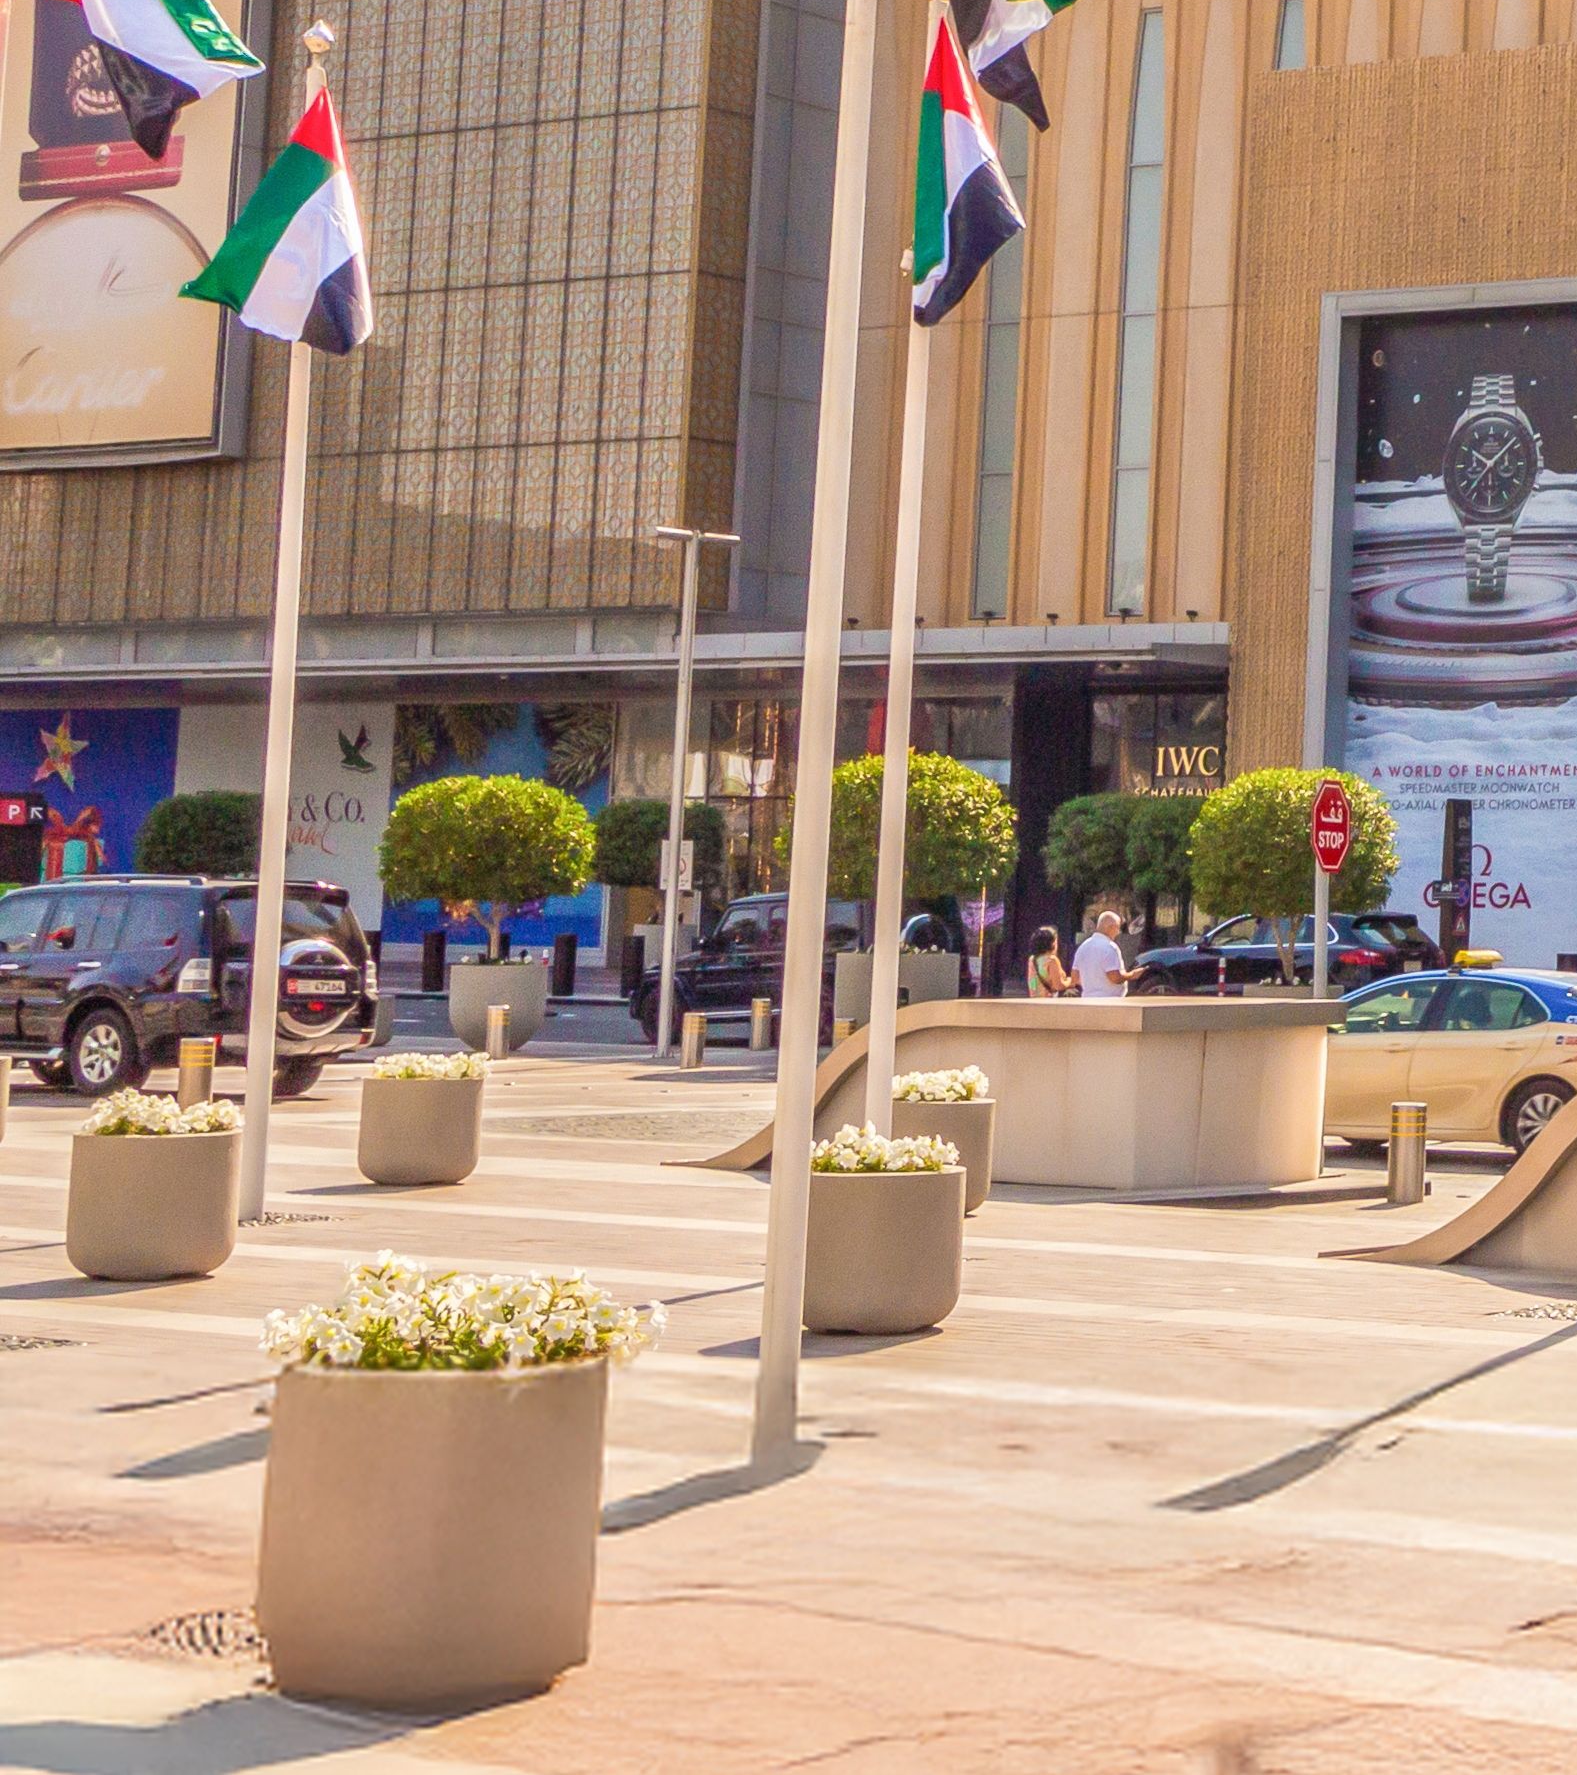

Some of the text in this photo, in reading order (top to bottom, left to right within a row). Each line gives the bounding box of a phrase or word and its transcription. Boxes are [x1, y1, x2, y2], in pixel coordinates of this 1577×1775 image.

[1156, 746, 1219, 776] IWC
[1372, 766, 1382, 778] A
[1389, 765, 1442, 778] WORLD
[1448, 764, 1469, 777] OF
[1400, 781, 1560, 794] SPEEDMASTER MOONWATCH
[9, 804, 21, 820] P
[1320, 799, 1344, 824] قف
[1488, 798, 1577, 810] CHRONOMETER
[1318, 830, 1345, 849] STOP
